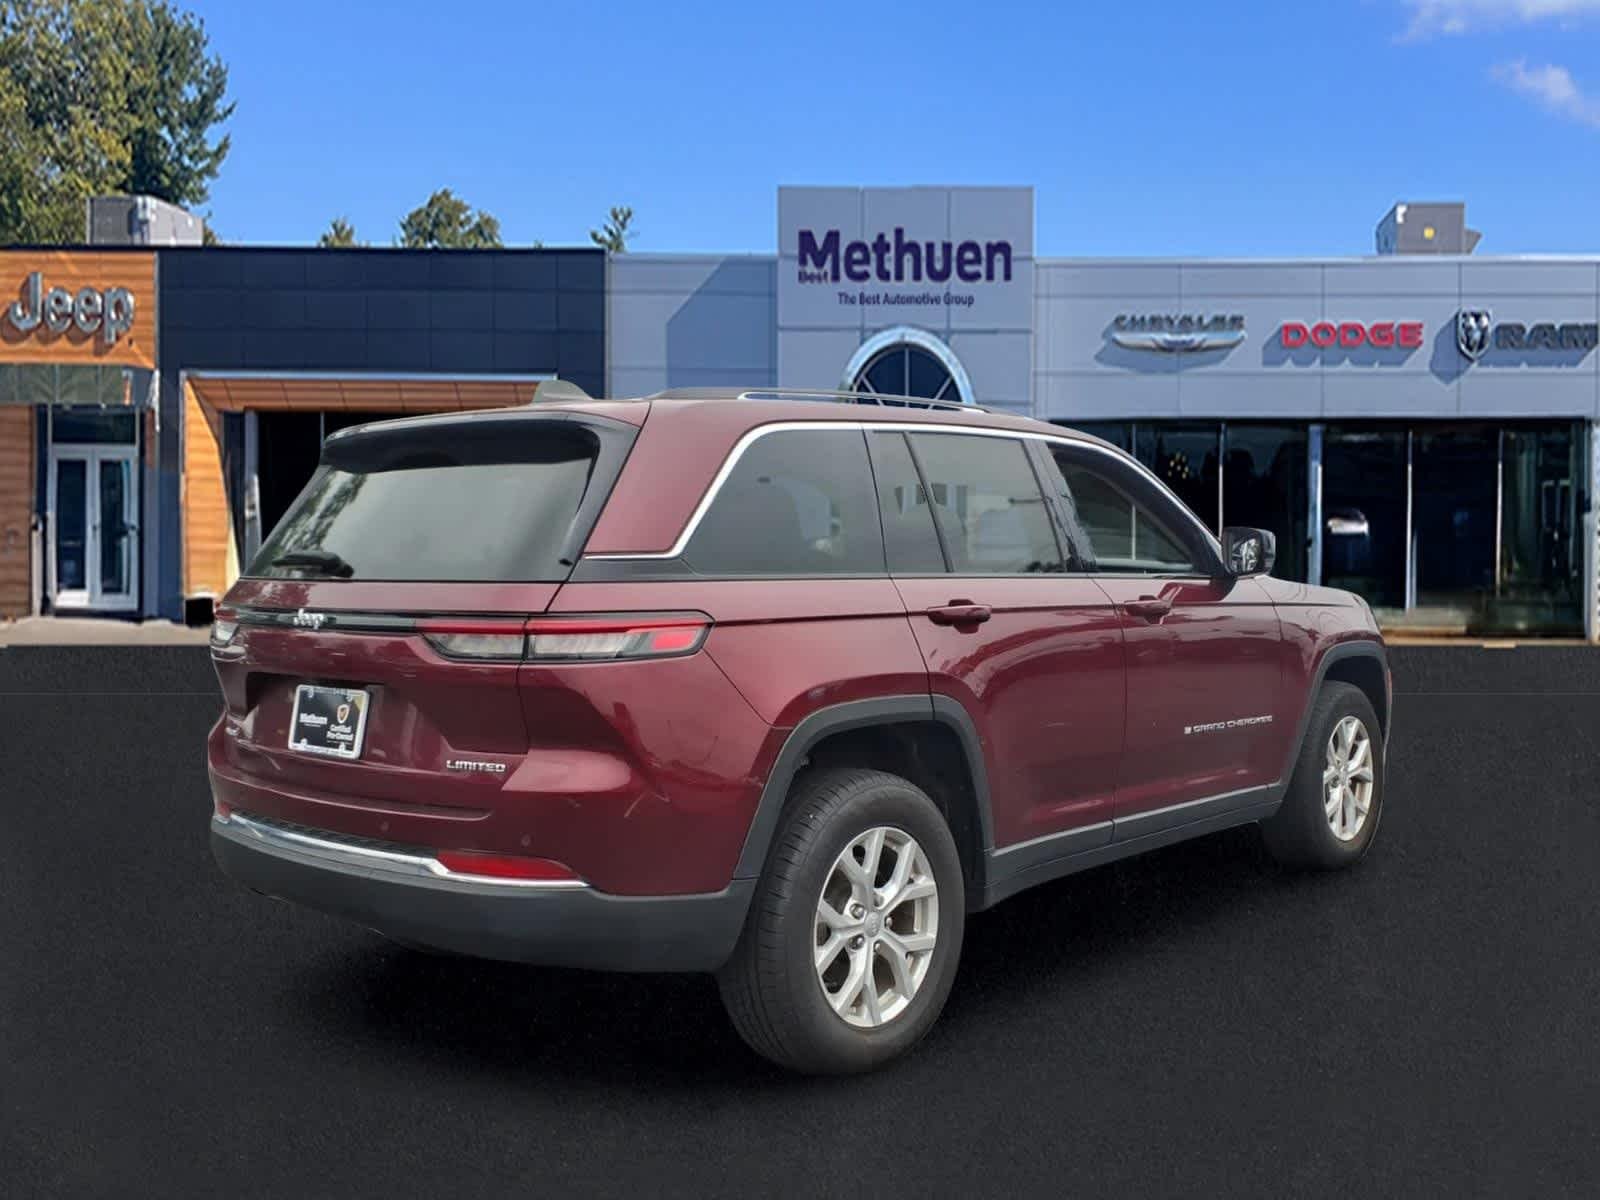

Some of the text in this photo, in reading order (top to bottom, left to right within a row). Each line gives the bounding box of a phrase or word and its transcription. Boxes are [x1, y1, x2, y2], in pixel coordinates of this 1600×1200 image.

[798, 227, 1012, 282] Methuen
[798, 271, 829, 283] Best
[9, 272, 135, 344] Jeep
[838, 292, 974, 308] The Best Automotive Group
[1114, 314, 1244, 331] CHRYSLER
[1281, 322, 1424, 348] DODGE
[1495, 323, 1599, 350] RAM
[1193, 715, 1273, 733] GRAND CHEROKEE
[446, 760, 506, 772] LIMITED
